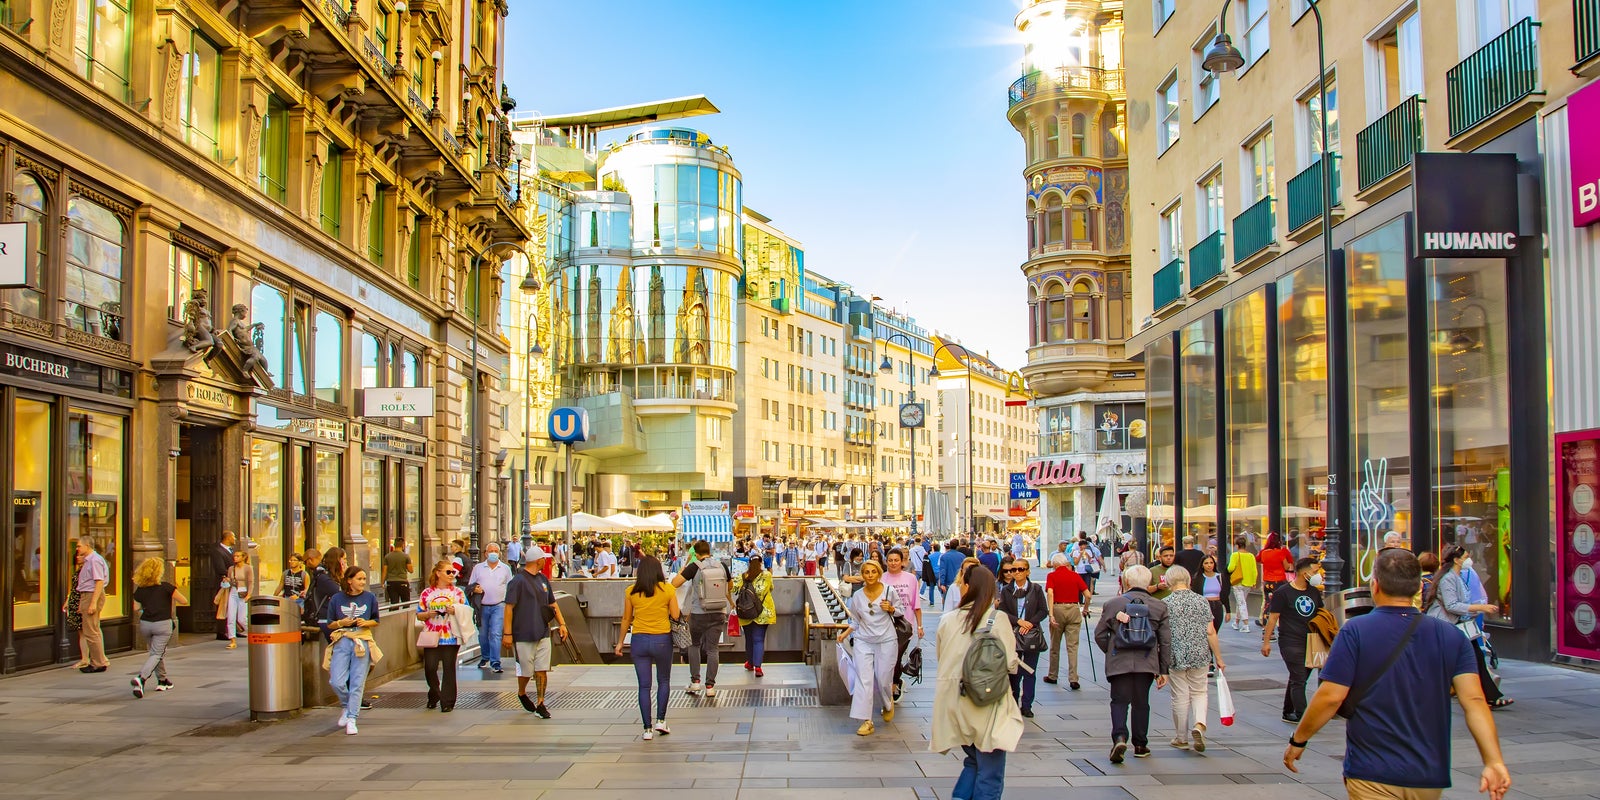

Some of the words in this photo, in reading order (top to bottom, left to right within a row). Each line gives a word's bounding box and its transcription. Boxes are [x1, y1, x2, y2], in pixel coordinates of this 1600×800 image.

[1578, 179, 1600, 214] B
[1424, 232, 1517, 250] HUMANIC
[5, 352, 70, 379] BUCHERER
[196, 387, 224, 404] ROLEX
[381, 403, 416, 411] ROLEX
[553, 415, 575, 437] U
